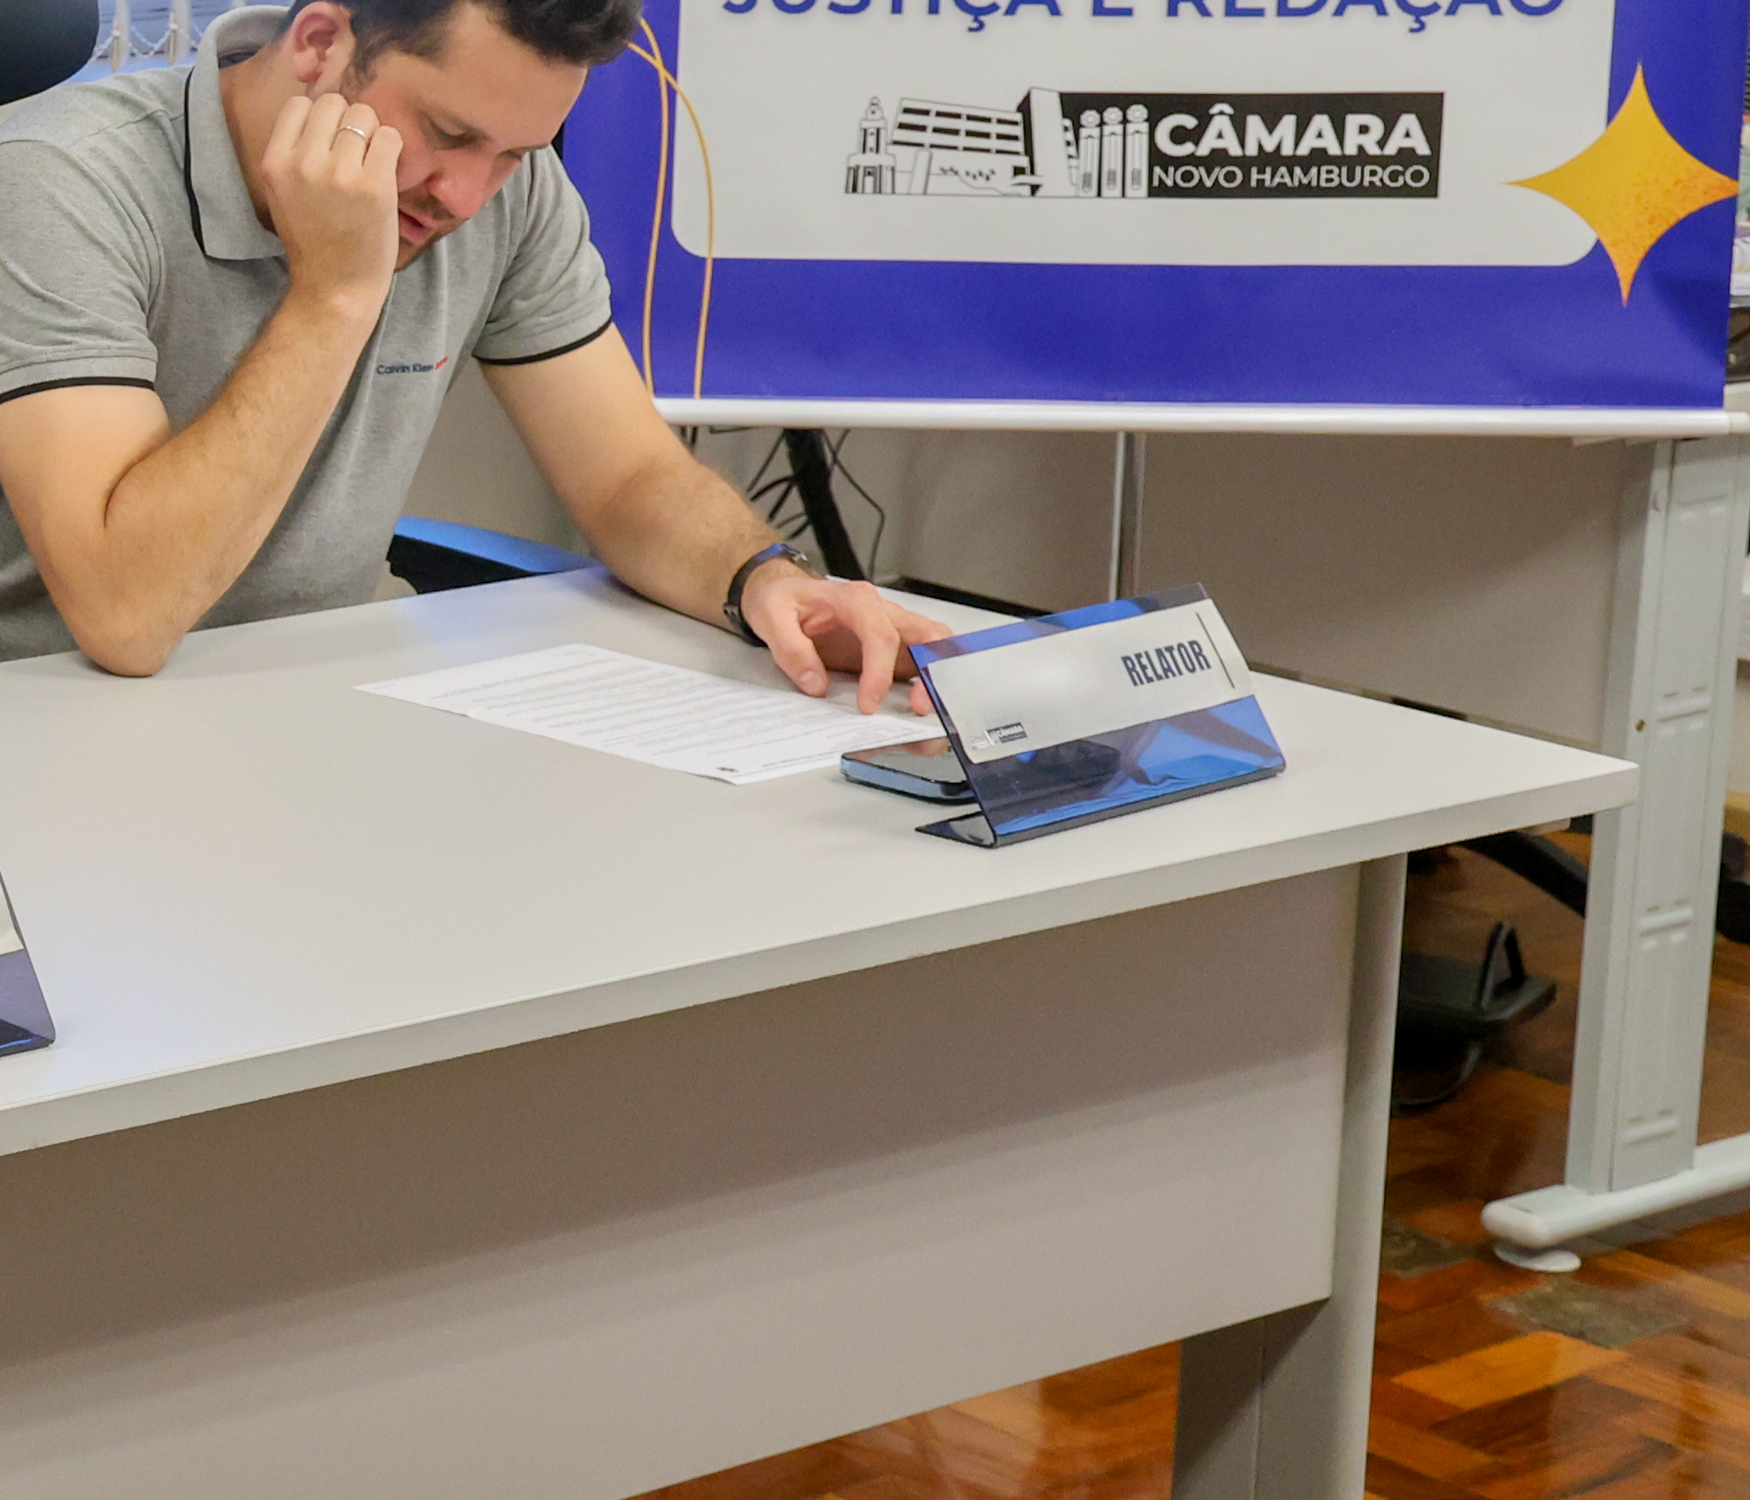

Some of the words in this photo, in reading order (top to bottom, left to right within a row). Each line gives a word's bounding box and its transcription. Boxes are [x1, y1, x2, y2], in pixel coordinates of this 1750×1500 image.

[1153, 102, 1432, 157] CÂMARA
[1152, 164, 1244, 189] NOVO
[1249, 163, 1431, 188] HAMBURGO
[1121, 638, 1214, 688] RELATOR
